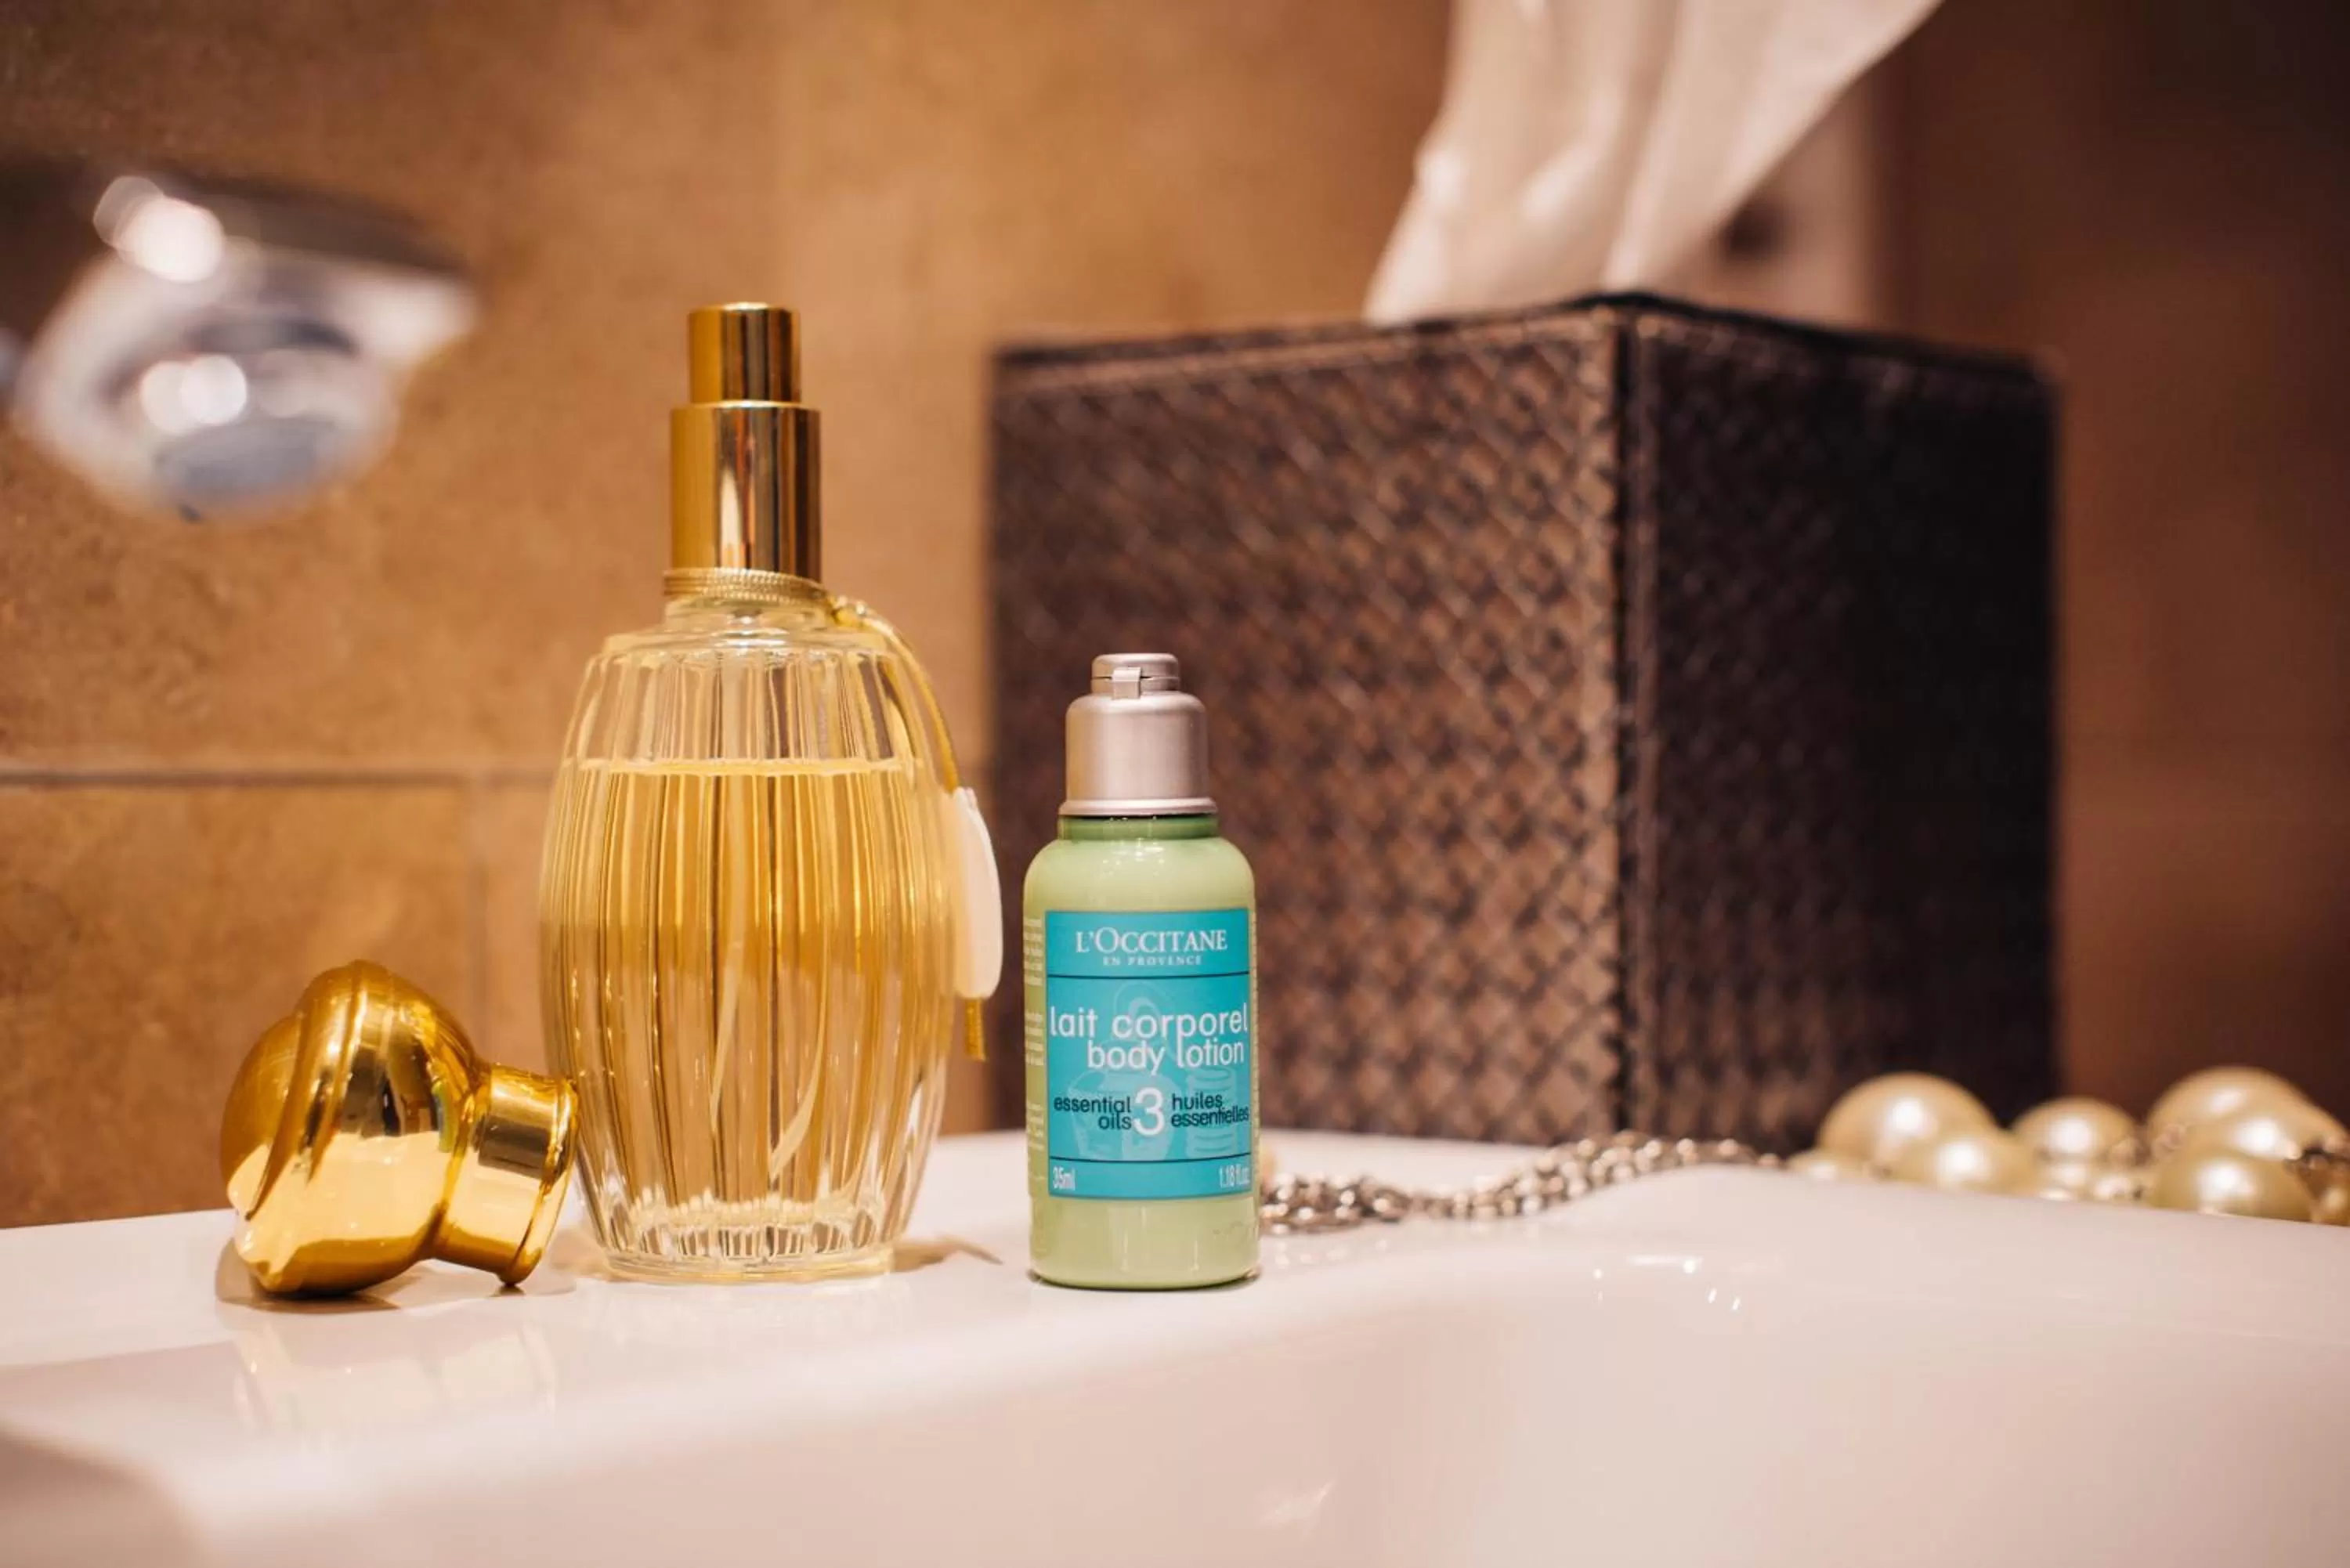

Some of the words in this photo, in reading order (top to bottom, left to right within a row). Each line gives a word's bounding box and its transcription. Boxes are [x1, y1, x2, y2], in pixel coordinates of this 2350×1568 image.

[1103, 955, 1120, 966] EN
[1128, 956, 1202, 966] PROVENCE
[1050, 1006, 1098, 1038] lait
[1112, 1002, 1249, 1046] corporel
[1087, 1039, 1166, 1076] body
[1177, 1038, 1245, 1068] lotion
[1054, 1096, 1132, 1113] essential
[1133, 1086, 1166, 1136] 3
[1172, 1093, 1223, 1110] huiles
[1098, 1112, 1132, 1130] oils
[1171, 1106, 1250, 1128] essentielles
